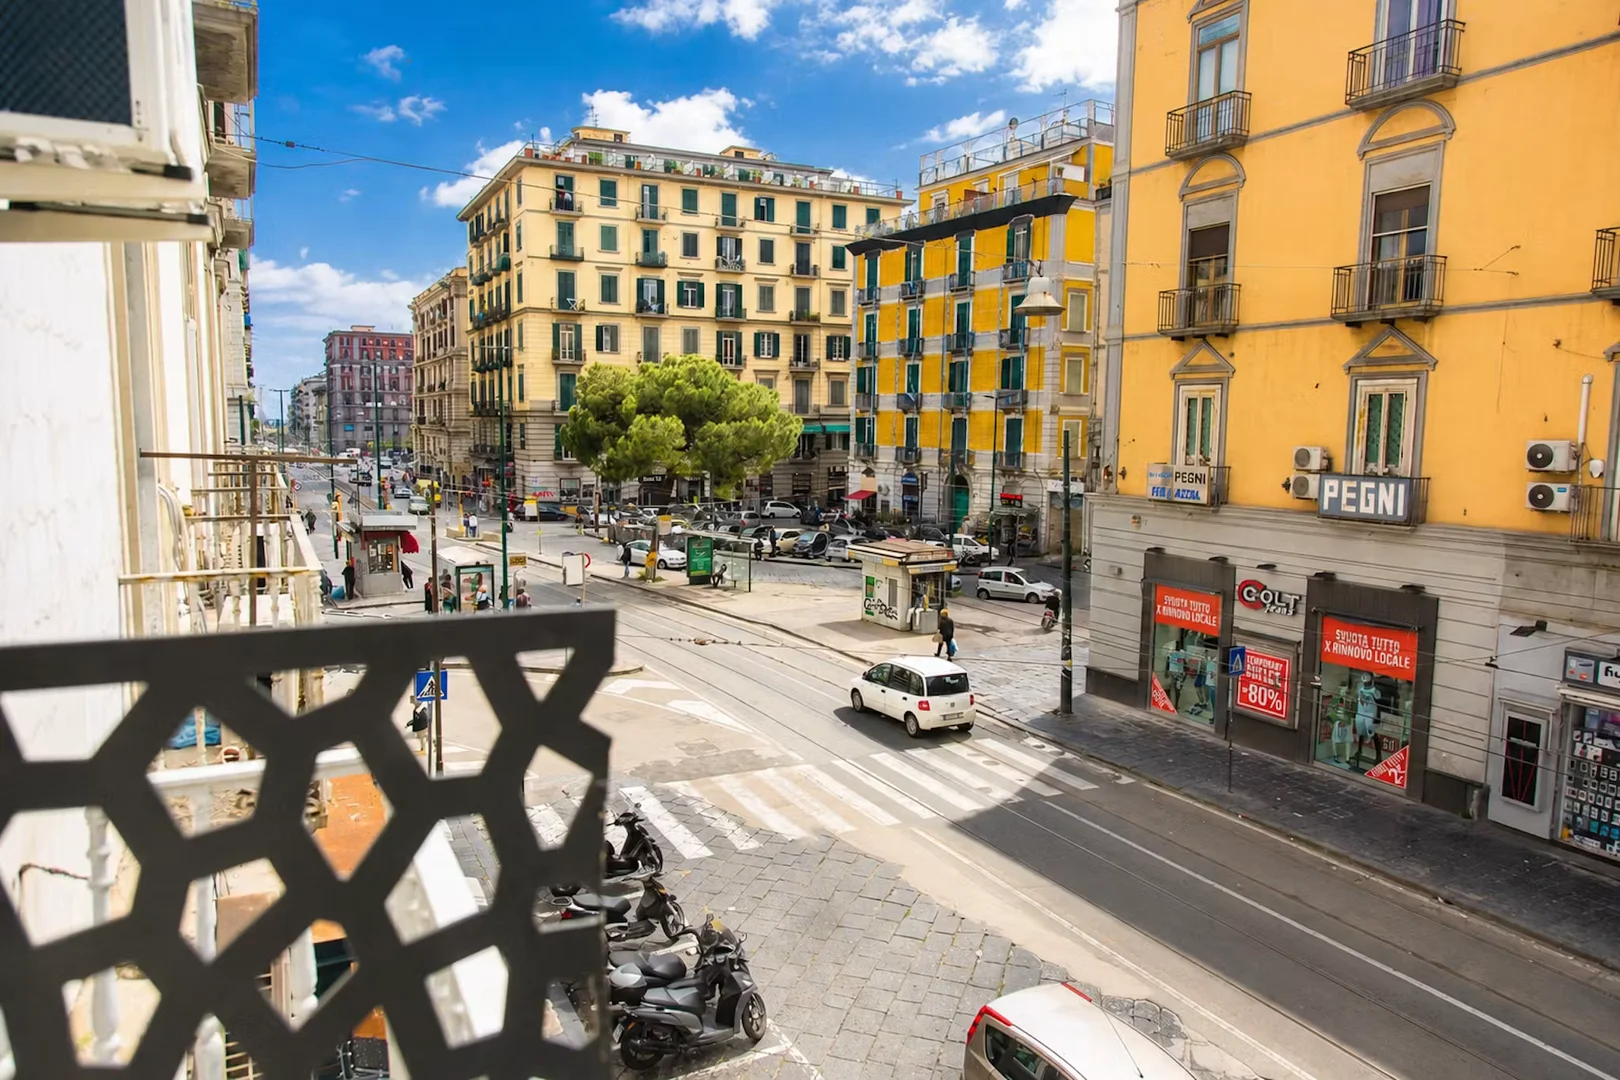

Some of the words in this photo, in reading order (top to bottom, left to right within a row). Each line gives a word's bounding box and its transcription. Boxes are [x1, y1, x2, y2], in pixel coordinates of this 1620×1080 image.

[1174, 471, 1206, 484] PEGNI
[1323, 479, 1405, 516] PEGNI
[1156, 604, 1162, 615] X
[1191, 612, 1217, 627] LOCALE
[1190, 600, 1211, 614] TUTTO
[1335, 629, 1369, 648] SVUOTA
[1371, 636, 1400, 654] TUTTO
[1324, 640, 1331, 652] X
[1332, 643, 1373, 661] RINNOVO
[1374, 651, 1410, 669] LOCALE
